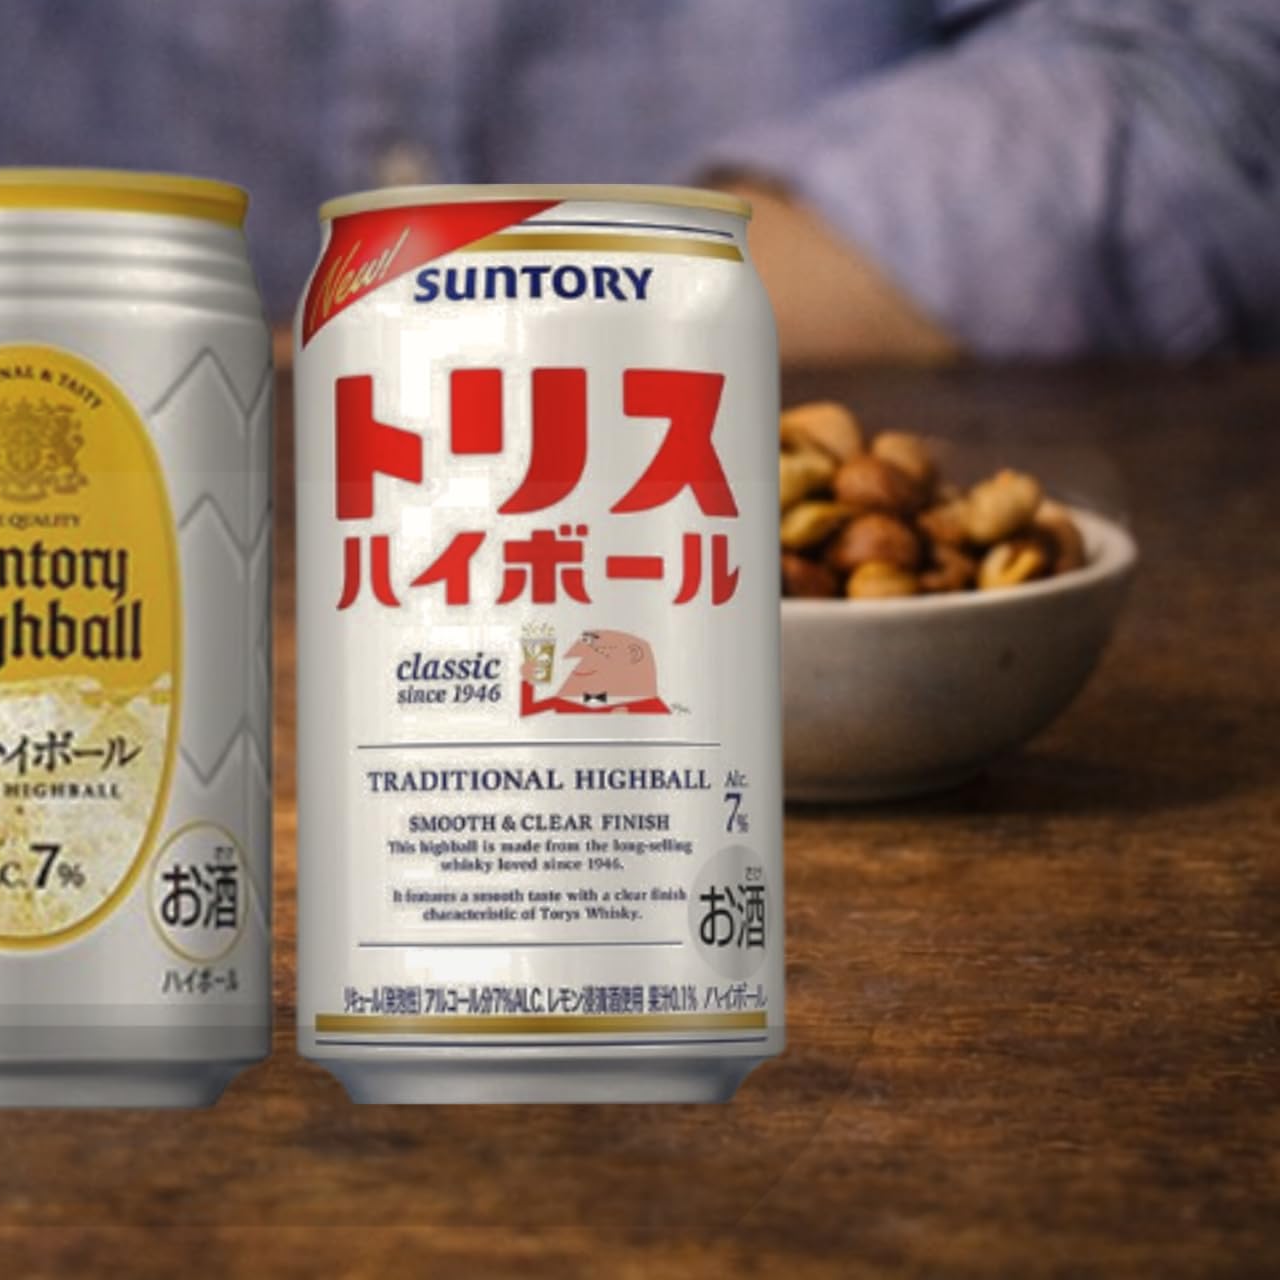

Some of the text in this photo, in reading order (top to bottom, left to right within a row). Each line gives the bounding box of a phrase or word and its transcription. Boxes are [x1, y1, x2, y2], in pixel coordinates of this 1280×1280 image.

[414, 265, 653, 302] SUNTORY
[334, 367, 740, 521] トリス
[335, 524, 740, 611] ハイボール
[396, 651, 502, 680] classic
[397, 684, 502, 704] since 1946
[4, 782, 122, 798] HIGHBALL
[367, 769, 711, 792] TRADITIONAL HIGHBALL
[409, 814, 671, 833] SMOOTH & CLEAR FINISH
[387, 838, 693, 856] This highball is made from the long-selling
[440, 857, 493, 873] whisky
[498, 857, 538, 871] loved
[542, 857, 582, 870] since
[162, 864, 237, 929] お酒
[393, 890, 403, 903] It
[460, 893, 469, 903] a
[472, 889, 524, 903] smooth
[527, 890, 562, 902] taste
[567, 888, 598, 902] with
[602, 892, 611, 902] a
[614, 888, 648, 902] clear
[650, 887, 688, 901] finish
[423, 907, 518, 921] characteristic
[521, 907, 535, 921] of
[539, 907, 581, 922] Torys
[699, 885, 766, 950] お酒
